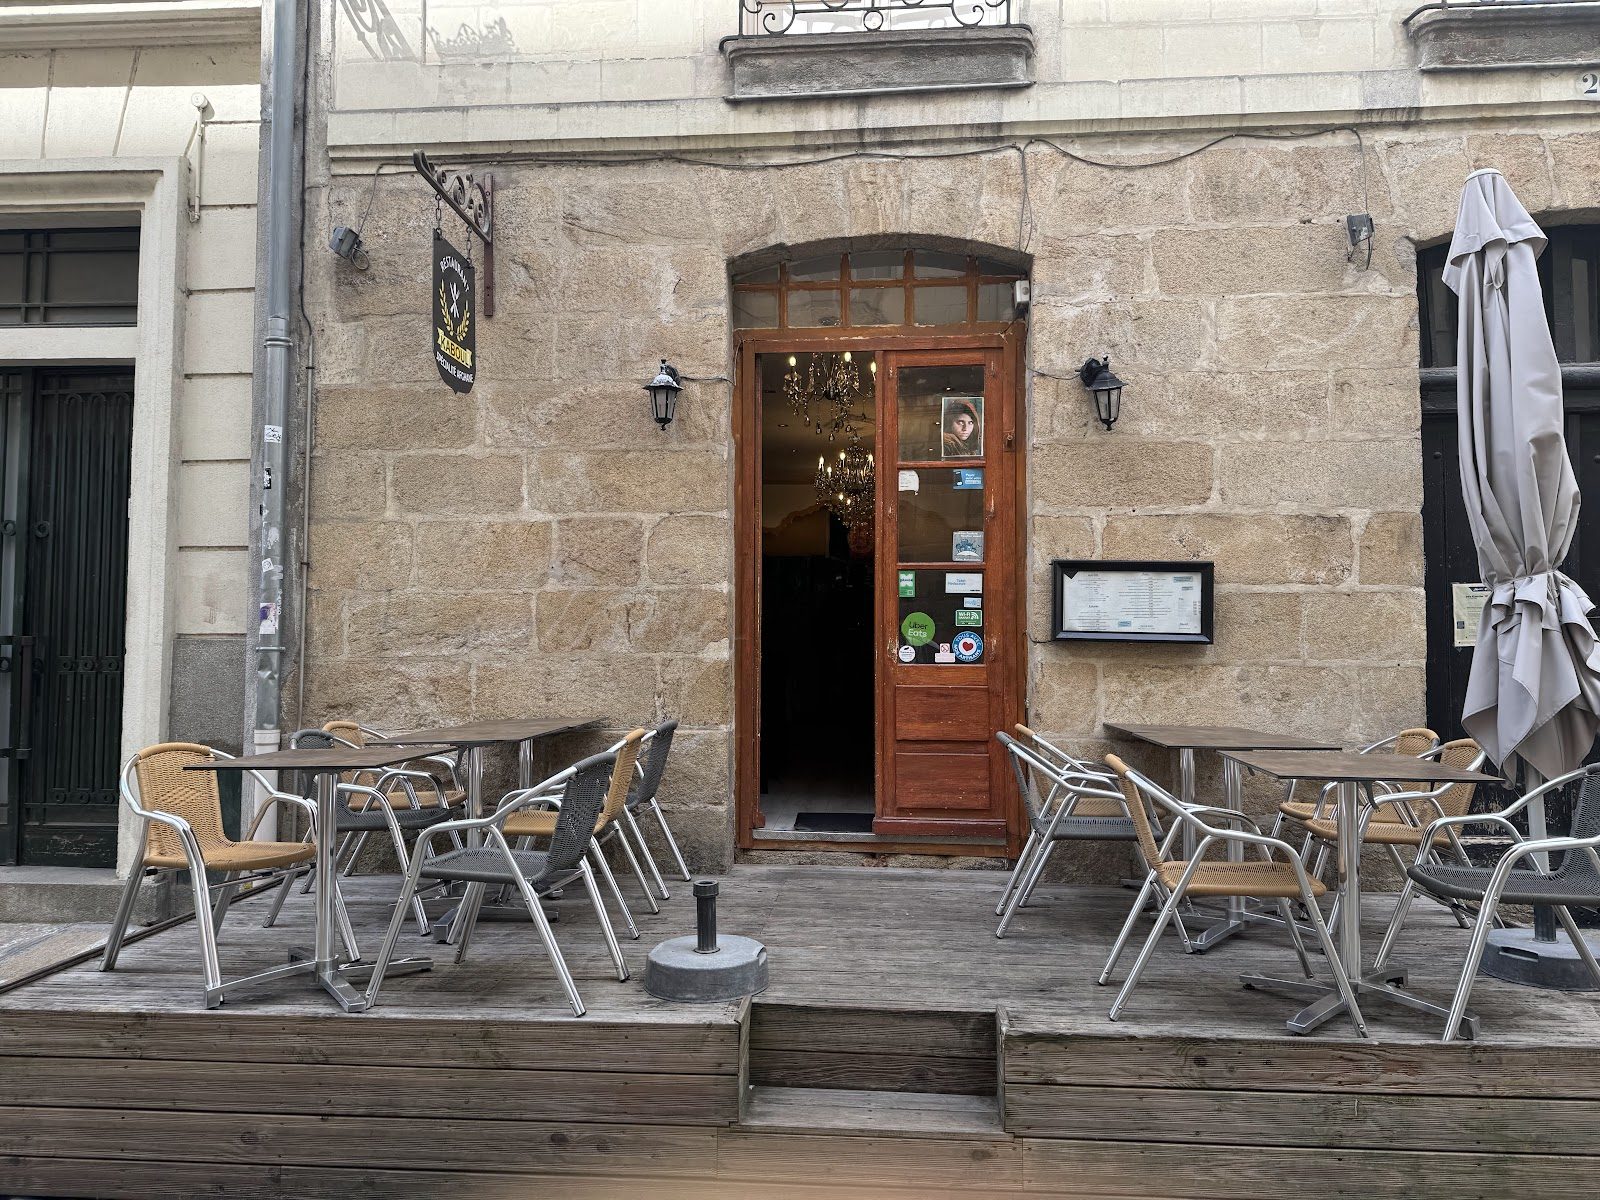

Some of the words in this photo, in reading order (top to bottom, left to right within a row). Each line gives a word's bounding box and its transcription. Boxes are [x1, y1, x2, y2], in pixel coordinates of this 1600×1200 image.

[440, 256, 469, 292] RESTAURANT
[441, 334, 469, 367] KABOUL
[909, 621, 928, 630] Uber
[908, 629, 928, 638] Eats
[955, 633, 970, 642] TOUS
